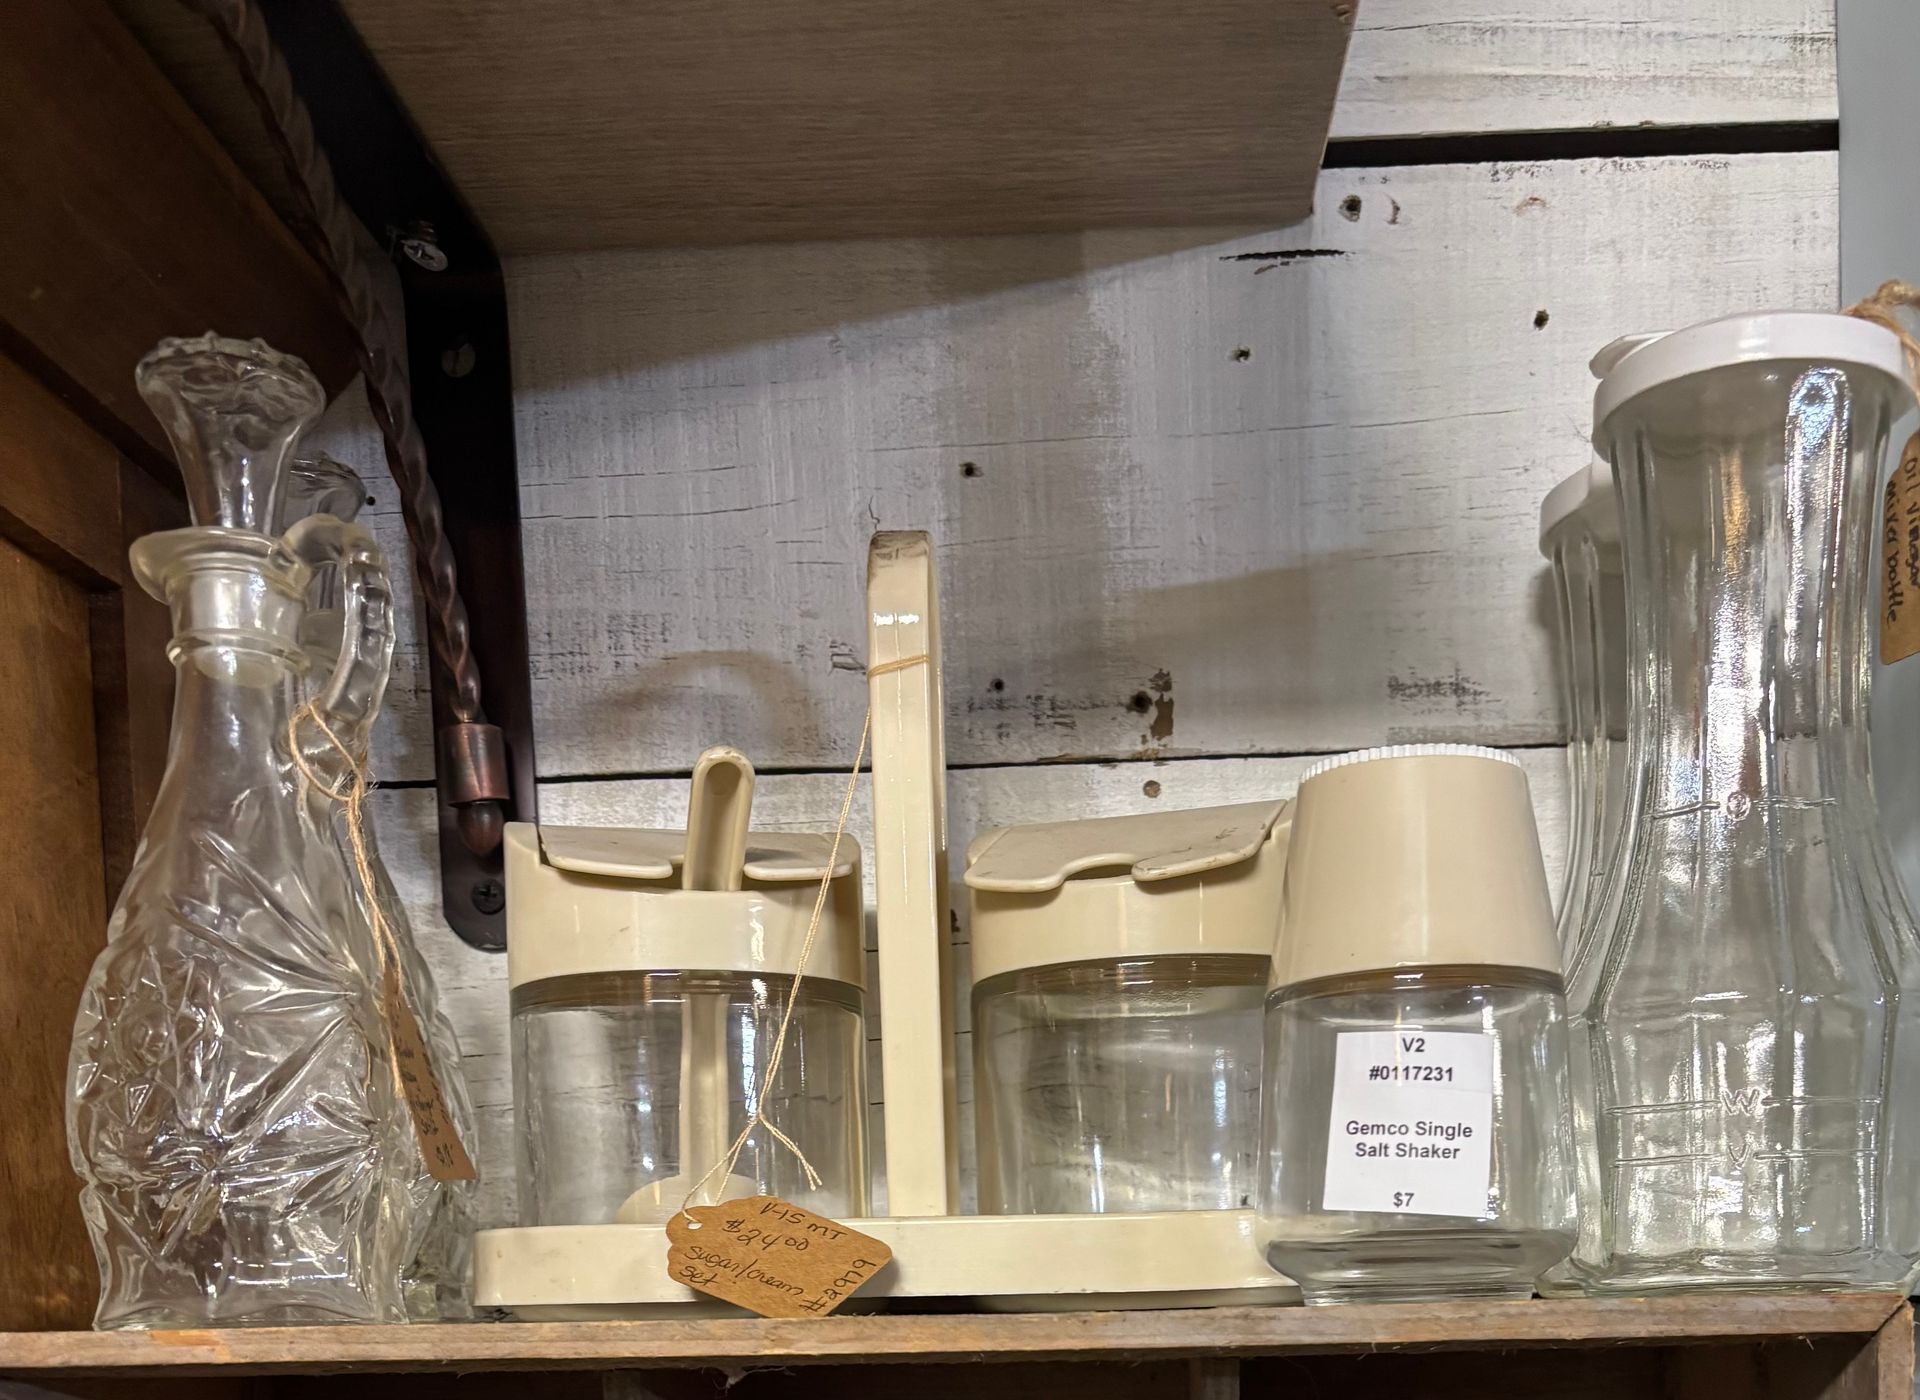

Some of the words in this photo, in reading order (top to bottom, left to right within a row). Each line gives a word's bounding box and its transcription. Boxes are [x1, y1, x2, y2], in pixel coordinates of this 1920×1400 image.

[1886, 549, 1904, 630] bottle
[1402, 1037, 1425, 1053] V2
[1368, 1065, 1453, 1082] #0117231
[1346, 1120, 1409, 1136] Gemco
[1414, 1121, 1473, 1141] Single
[1355, 1142, 1390, 1158] Salt
[1395, 1142, 1460, 1159] Shaker
[1393, 1191, 1415, 1208] $7
